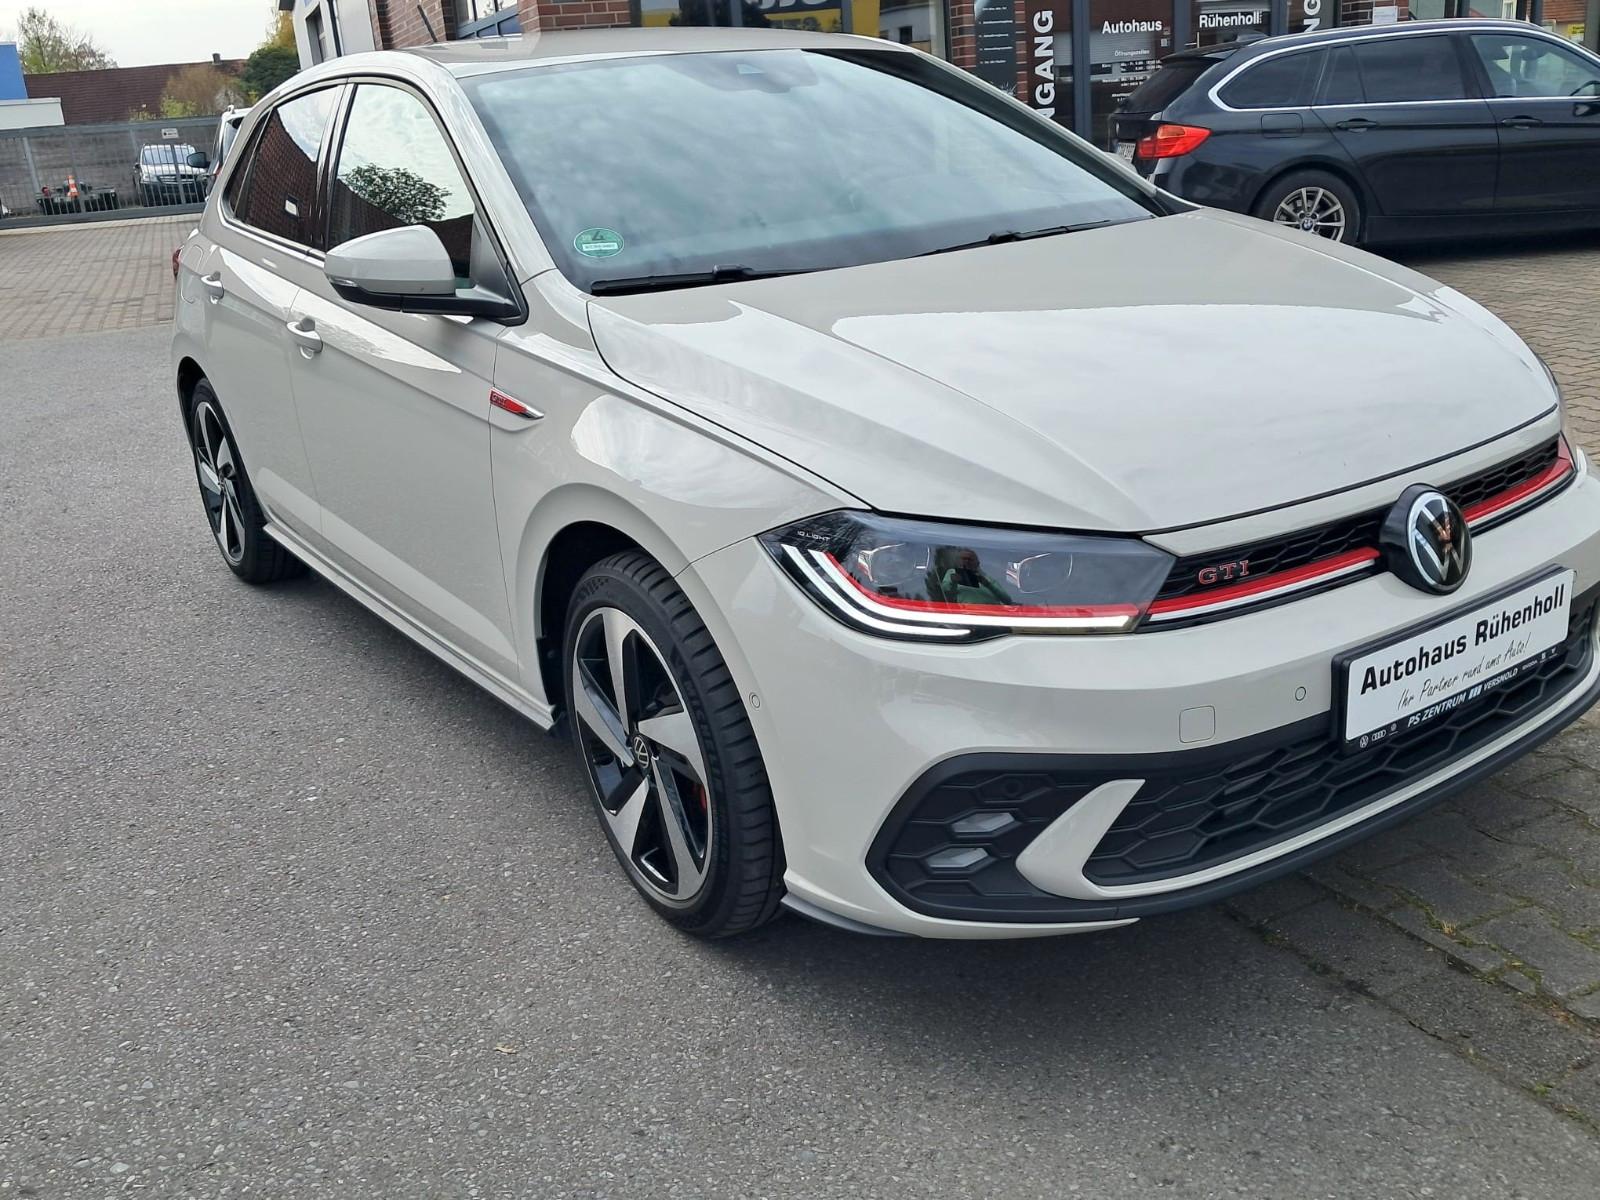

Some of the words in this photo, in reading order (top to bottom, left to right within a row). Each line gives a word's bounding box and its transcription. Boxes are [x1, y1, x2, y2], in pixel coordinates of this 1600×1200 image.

[1102, 19, 1162, 34] Autohaus
[1199, 11, 1260, 28] Rühenholl
[1198, 559, 1250, 585] GTI
[1360, 634, 1467, 695] Autohaus
[1474, 584, 1564, 646] Rühenholl
[1397, 688, 1414, 711] Ihr
[1419, 677, 1458, 701] Partner
[1462, 656, 1485, 682] rund
[1485, 656, 1501, 671] ums
[1503, 632, 1531, 662] Auto!
[1407, 715, 1421, 728] PS
[1421, 691, 1467, 721] ZENTRUM
[1483, 667, 1519, 691] VERSMOLD
